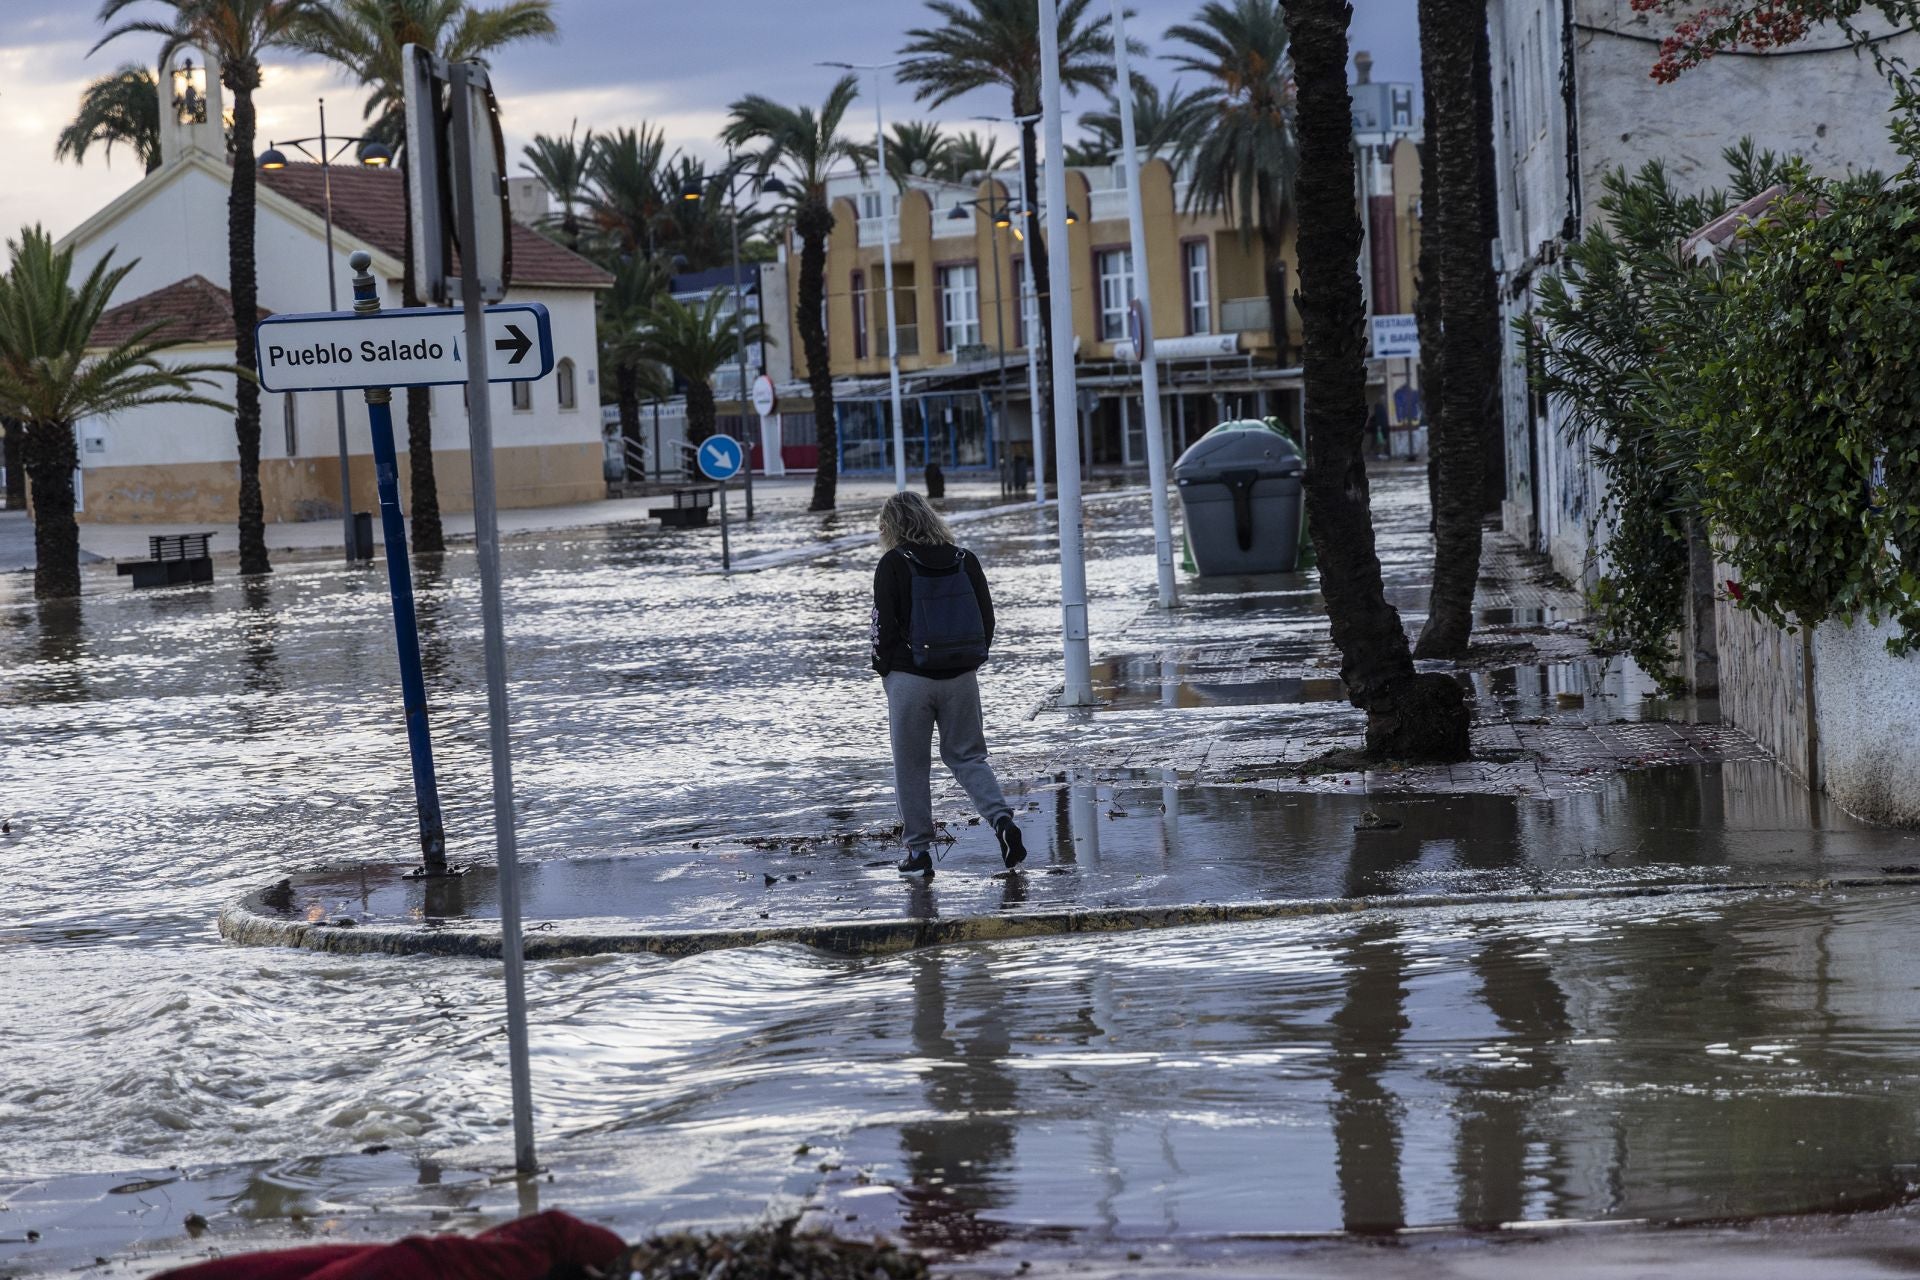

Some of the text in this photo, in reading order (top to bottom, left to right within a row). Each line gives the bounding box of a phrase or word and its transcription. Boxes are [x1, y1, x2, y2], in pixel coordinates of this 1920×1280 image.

[1391, 89, 1412, 126] H
[269, 338, 443, 367] Pueblo Salado
